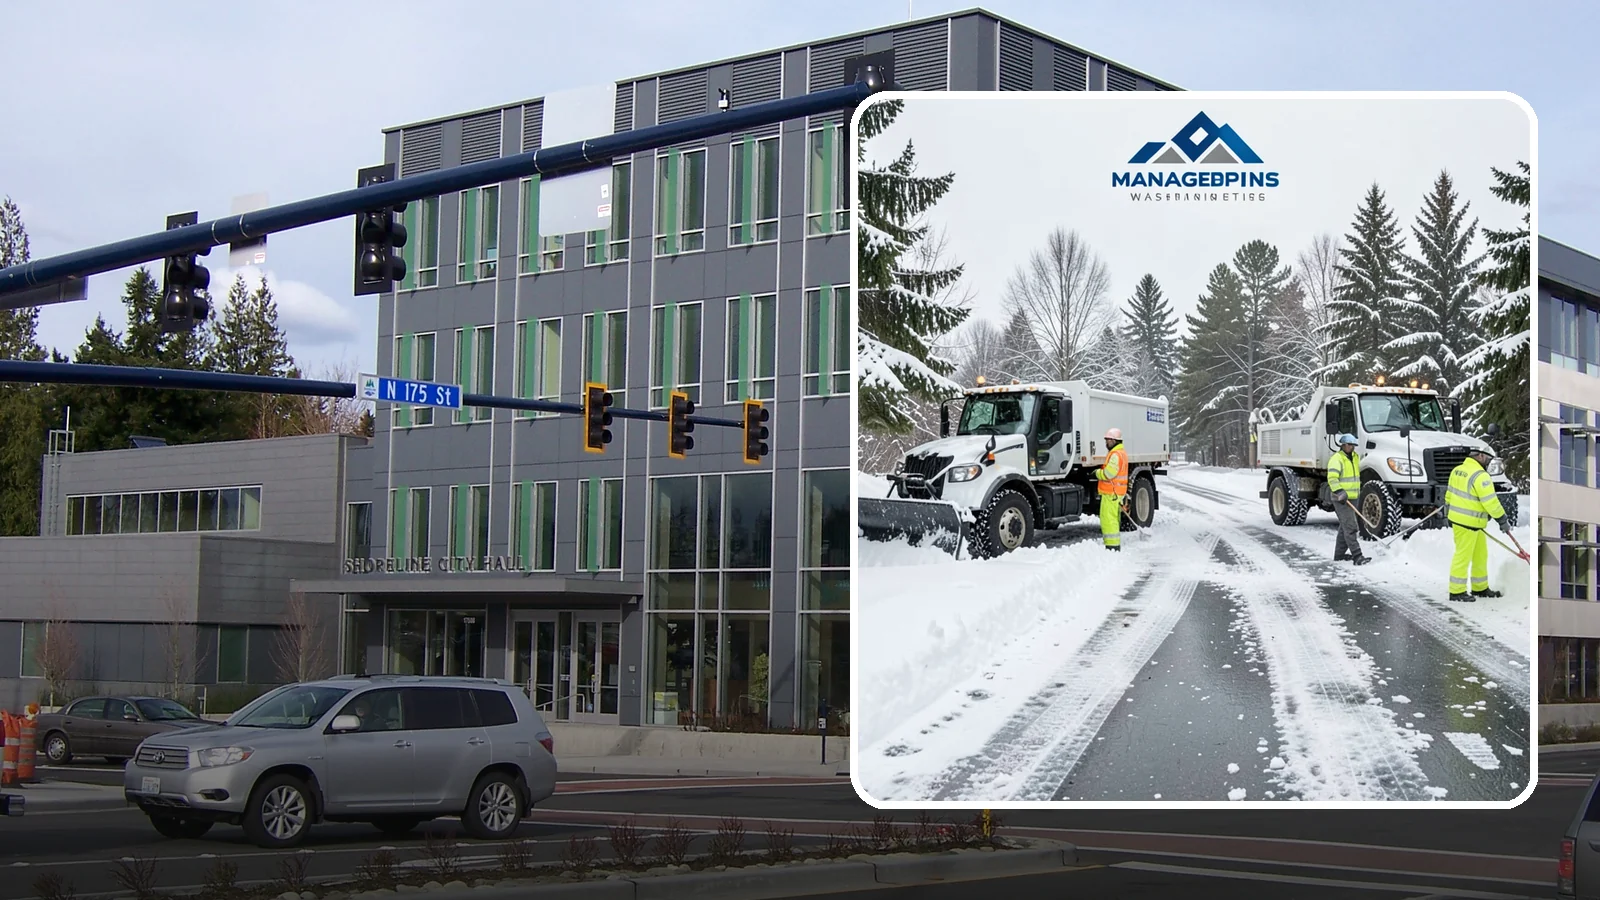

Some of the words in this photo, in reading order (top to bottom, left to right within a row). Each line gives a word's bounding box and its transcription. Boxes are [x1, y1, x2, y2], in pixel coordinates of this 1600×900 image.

[387, 380, 396, 399] N
[405, 382, 427, 403] 175
[436, 386, 451, 406] St
[344, 556, 432, 574] SHORELINE
[438, 556, 475, 572] CITY
[483, 555, 526, 572] HALL
